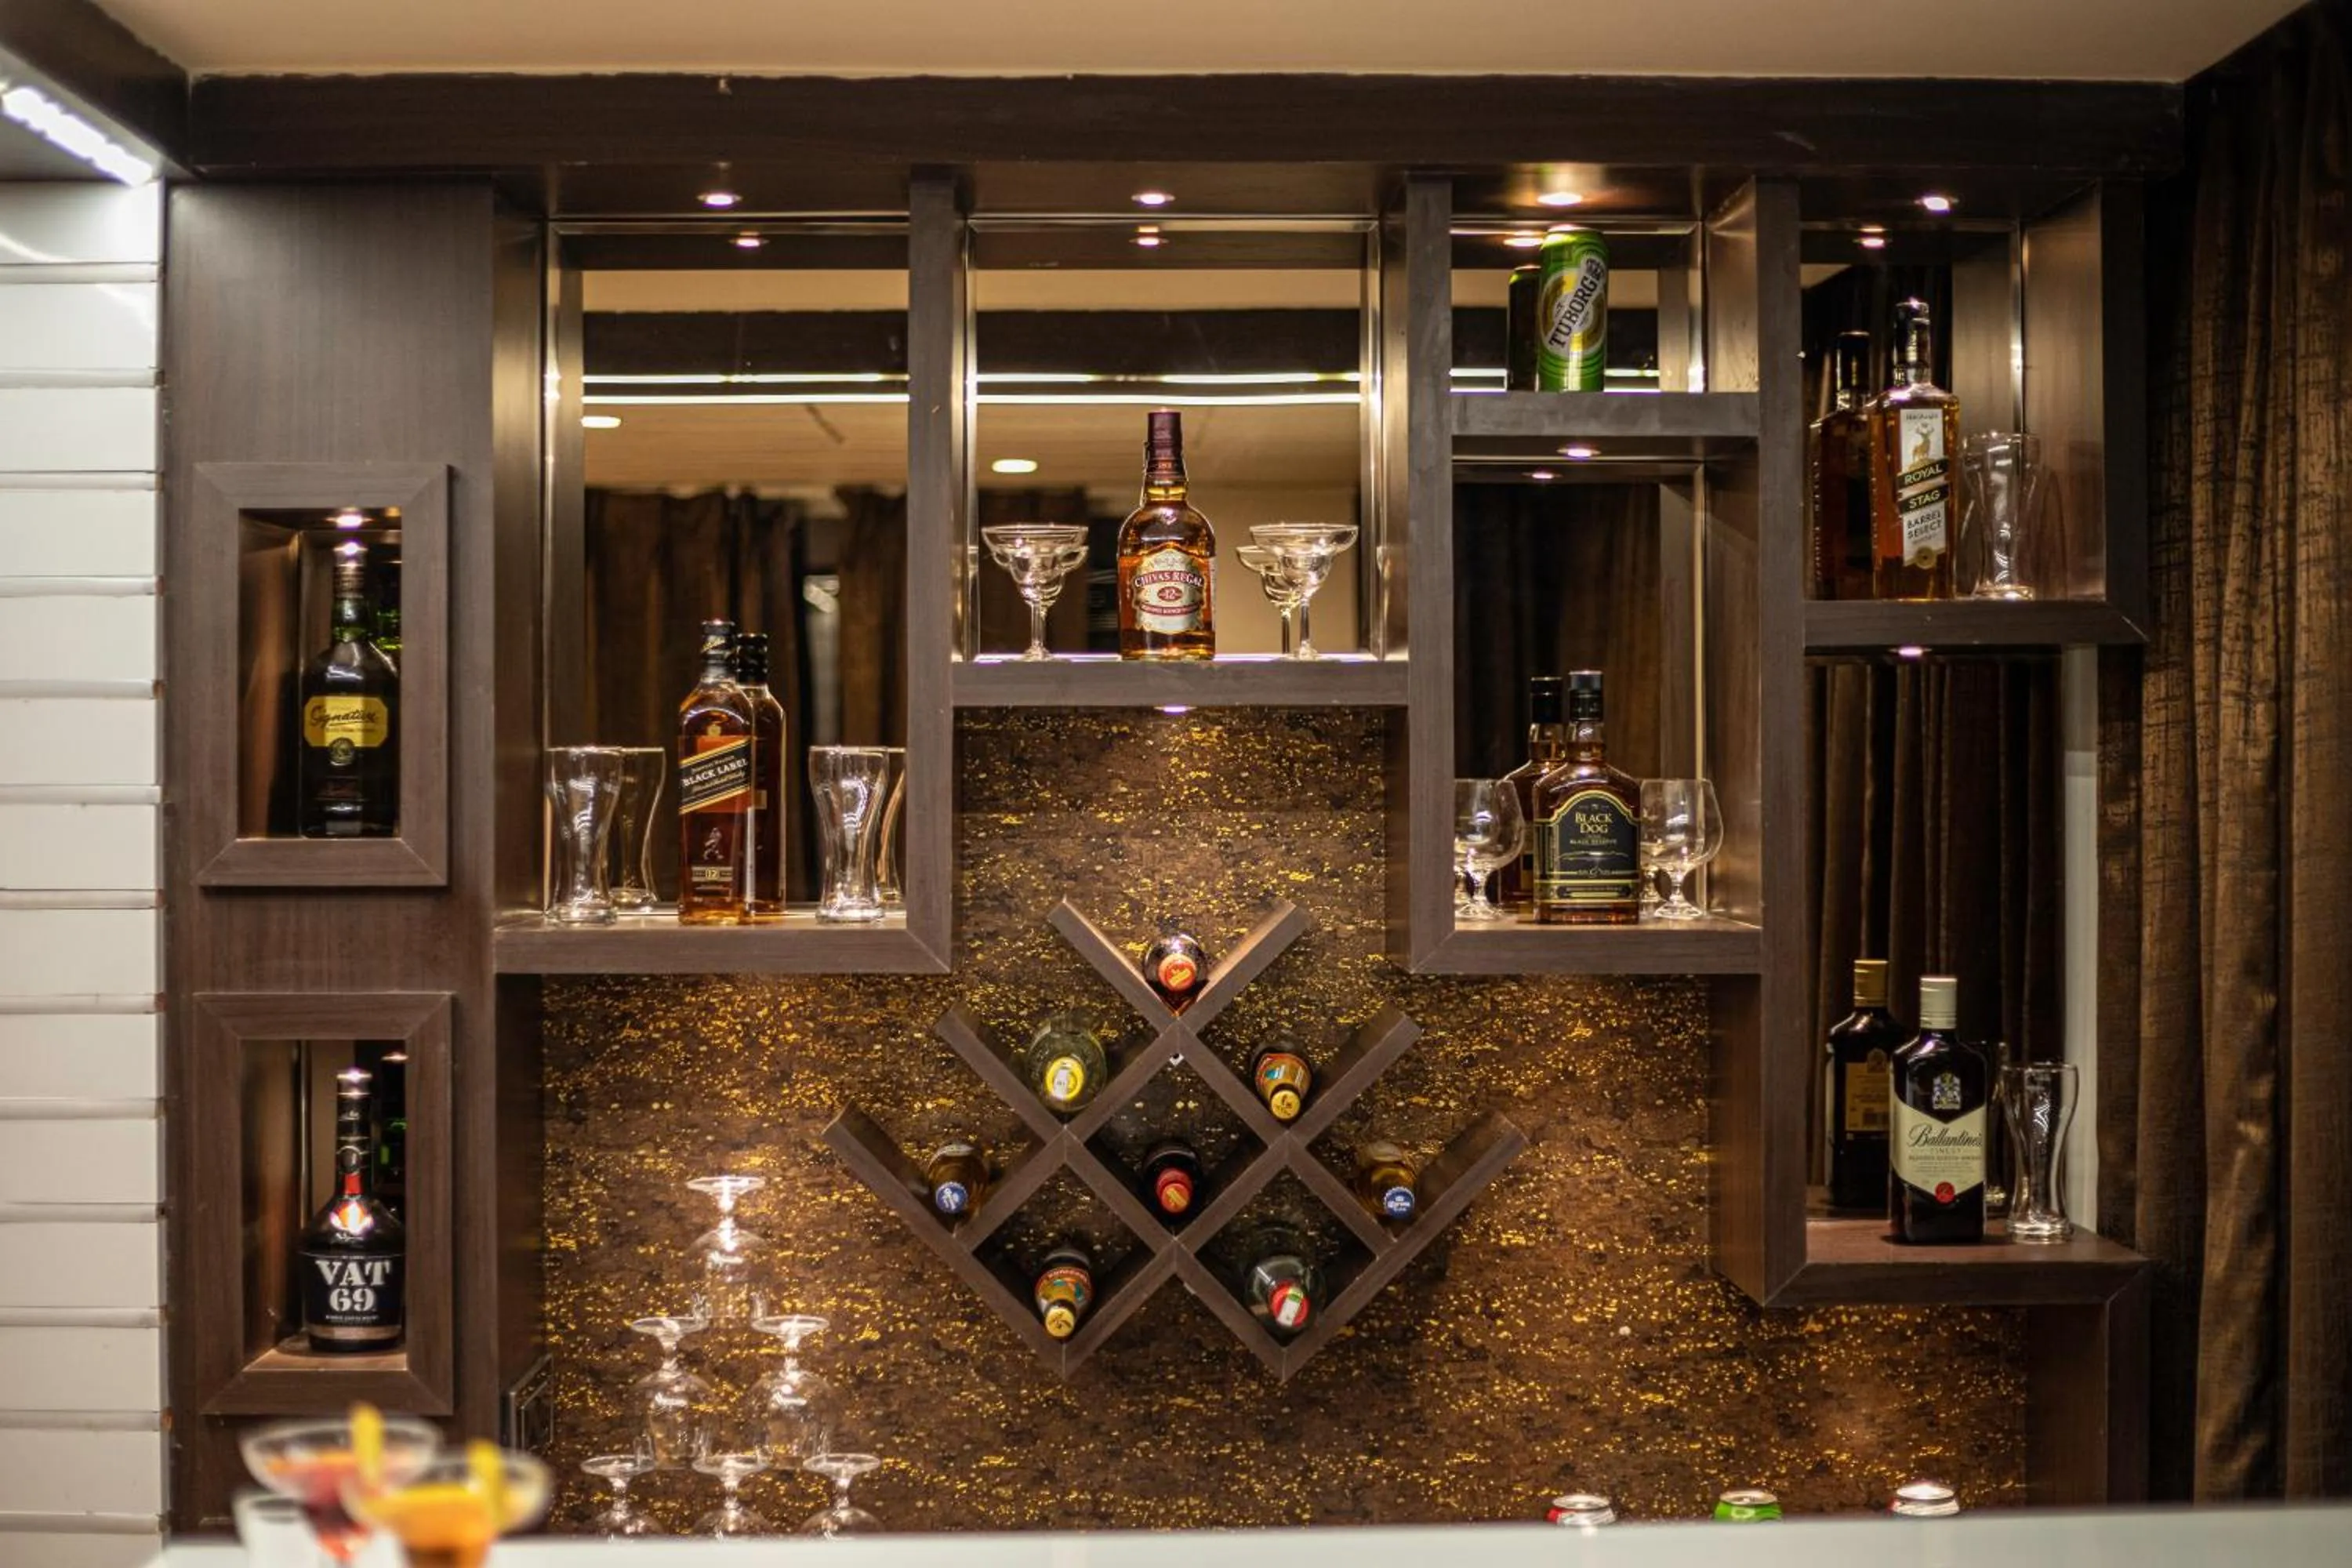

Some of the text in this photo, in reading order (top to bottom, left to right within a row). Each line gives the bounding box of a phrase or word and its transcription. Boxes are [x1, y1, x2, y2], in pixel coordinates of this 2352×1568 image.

[1548, 275, 1598, 347] TUBORG
[1904, 464, 1943, 485] ROYAL
[1909, 490, 1940, 509] STAG
[1907, 510, 1940, 528] BARREL
[1907, 520, 1941, 539] SELECT
[1134, 572, 1203, 587] CHIVAS REGAL
[1165, 589, 1176, 600] 12
[310, 705, 377, 728] Signature
[683, 769, 716, 787] BLACK
[717, 758, 748, 775] LABEL
[315, 1260, 390, 1286] VAT
[330, 1288, 375, 1312] 69
